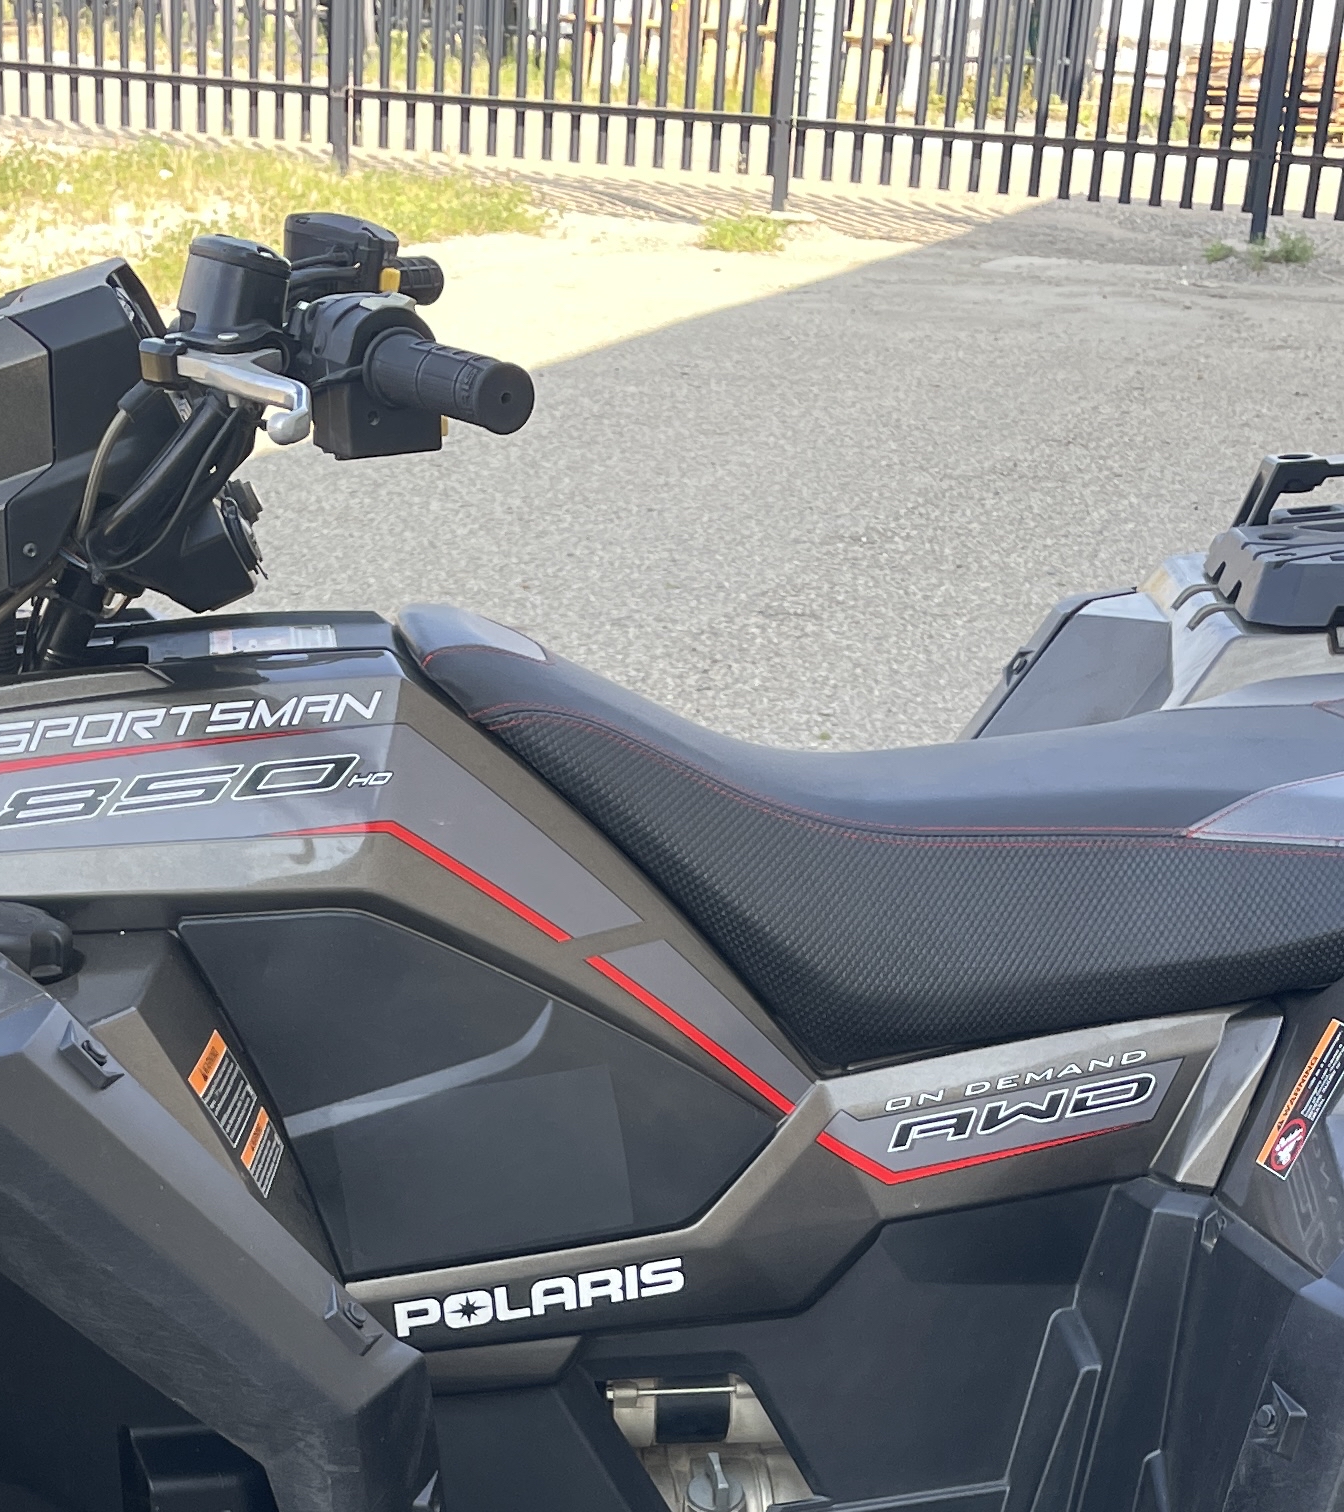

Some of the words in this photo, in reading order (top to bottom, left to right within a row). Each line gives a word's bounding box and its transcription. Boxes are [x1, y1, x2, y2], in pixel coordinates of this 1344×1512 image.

[348, 770, 394, 788] HO
[885, 1089, 944, 1112] ON
[965, 1050, 1148, 1097] DEMAND
[1282, 1056, 1319, 1116] WARNING
[887, 1073, 1156, 1152] AWD
[393, 1257, 685, 1338] POLARIS
